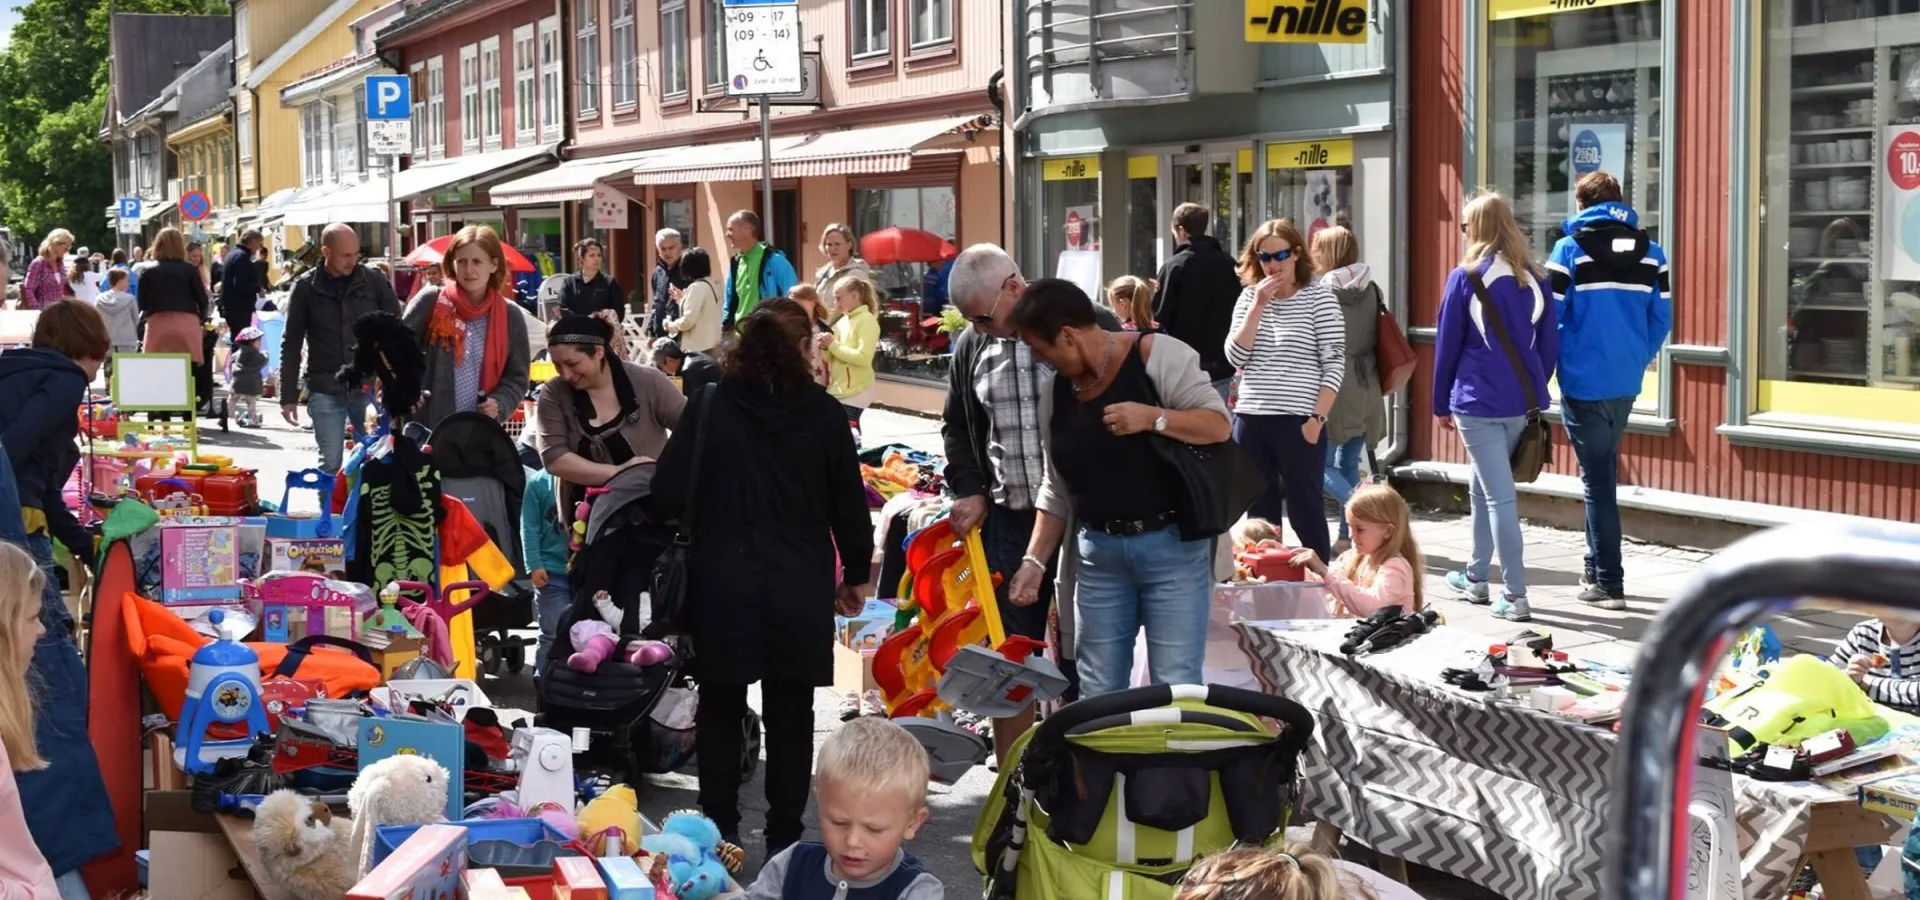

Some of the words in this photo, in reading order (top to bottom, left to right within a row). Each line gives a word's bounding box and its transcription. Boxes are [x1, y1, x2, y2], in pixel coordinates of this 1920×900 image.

[738, 12, 754, 23] 09
[773, 11, 784, 21] 17
[1250, 0, 1367, 36] -nille
[734, 29, 755, 41] (09
[774, 28, 791, 39] 14)
[377, 82, 401, 115] P
[1294, 144, 1329, 165] -nille
[125, 201, 137, 216] P
[287, 544, 344, 559] OPERATION
